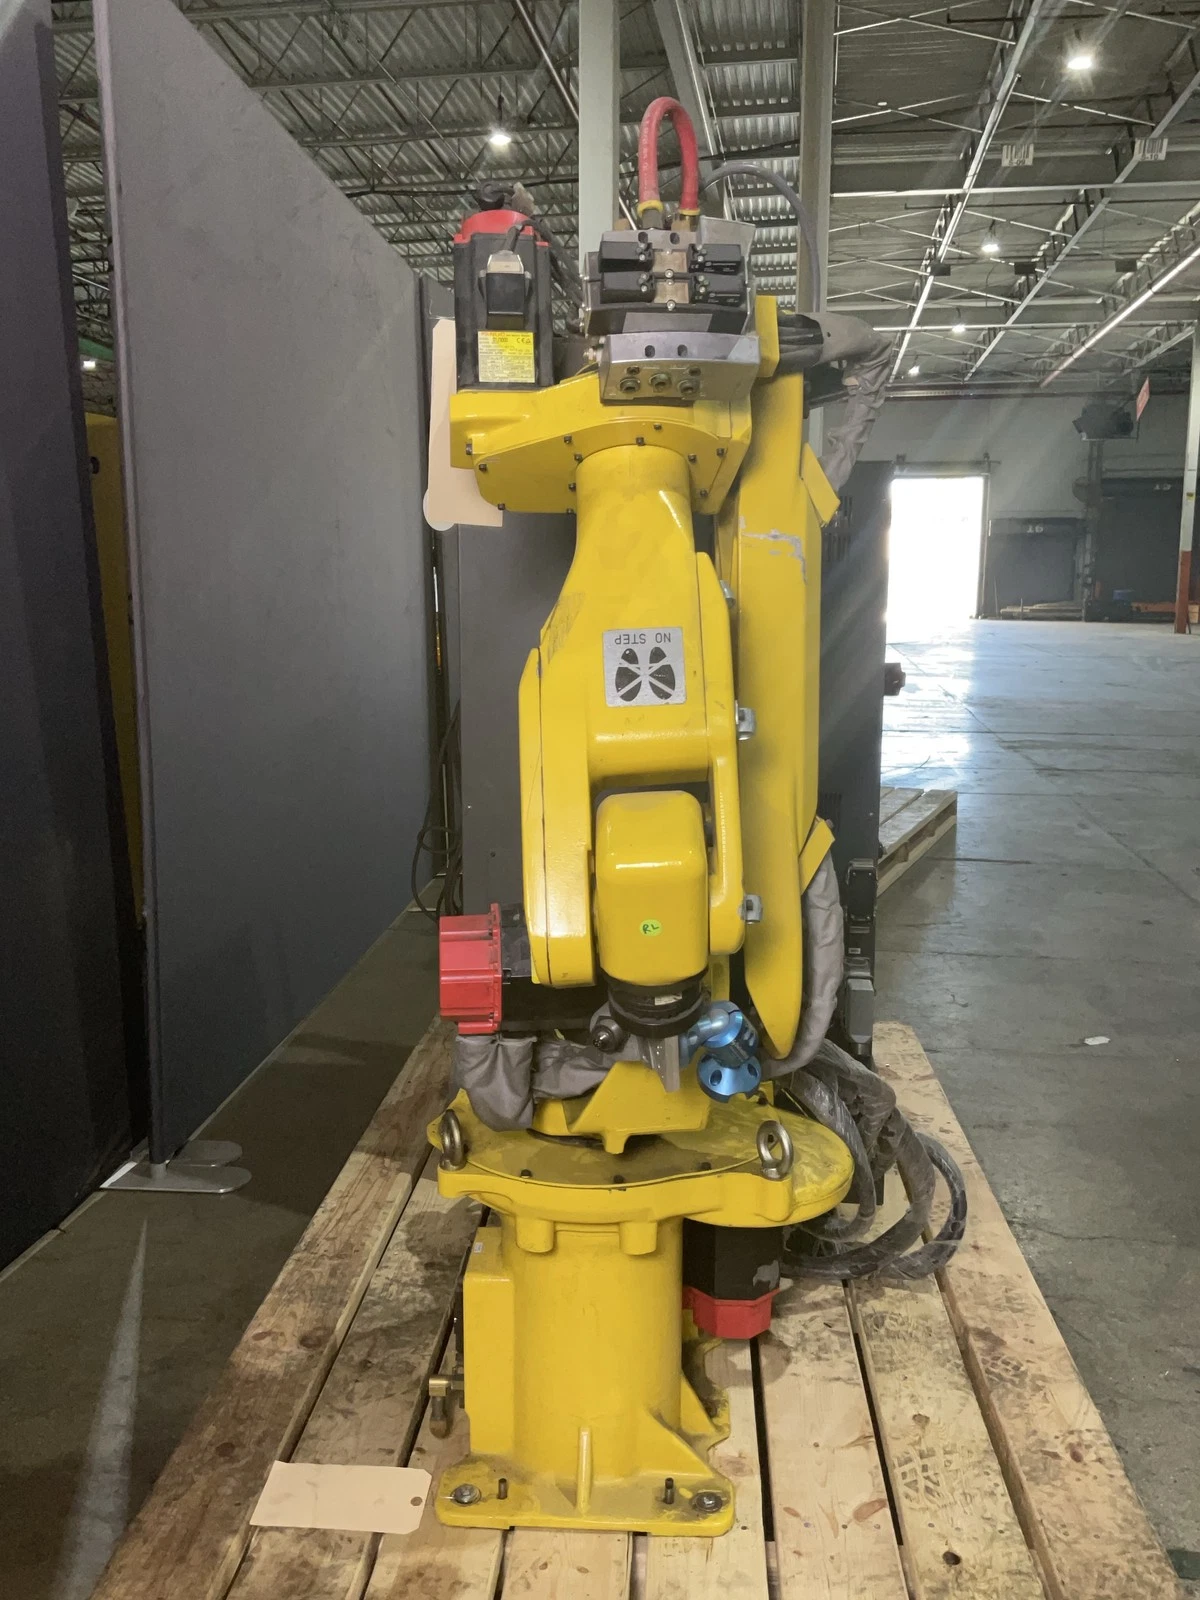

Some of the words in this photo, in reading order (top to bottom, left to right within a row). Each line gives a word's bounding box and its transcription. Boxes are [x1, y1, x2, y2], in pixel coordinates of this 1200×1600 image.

[614, 633, 647, 645] STEP
[655, 632, 672, 644] NO
[642, 923, 660, 935] RL
